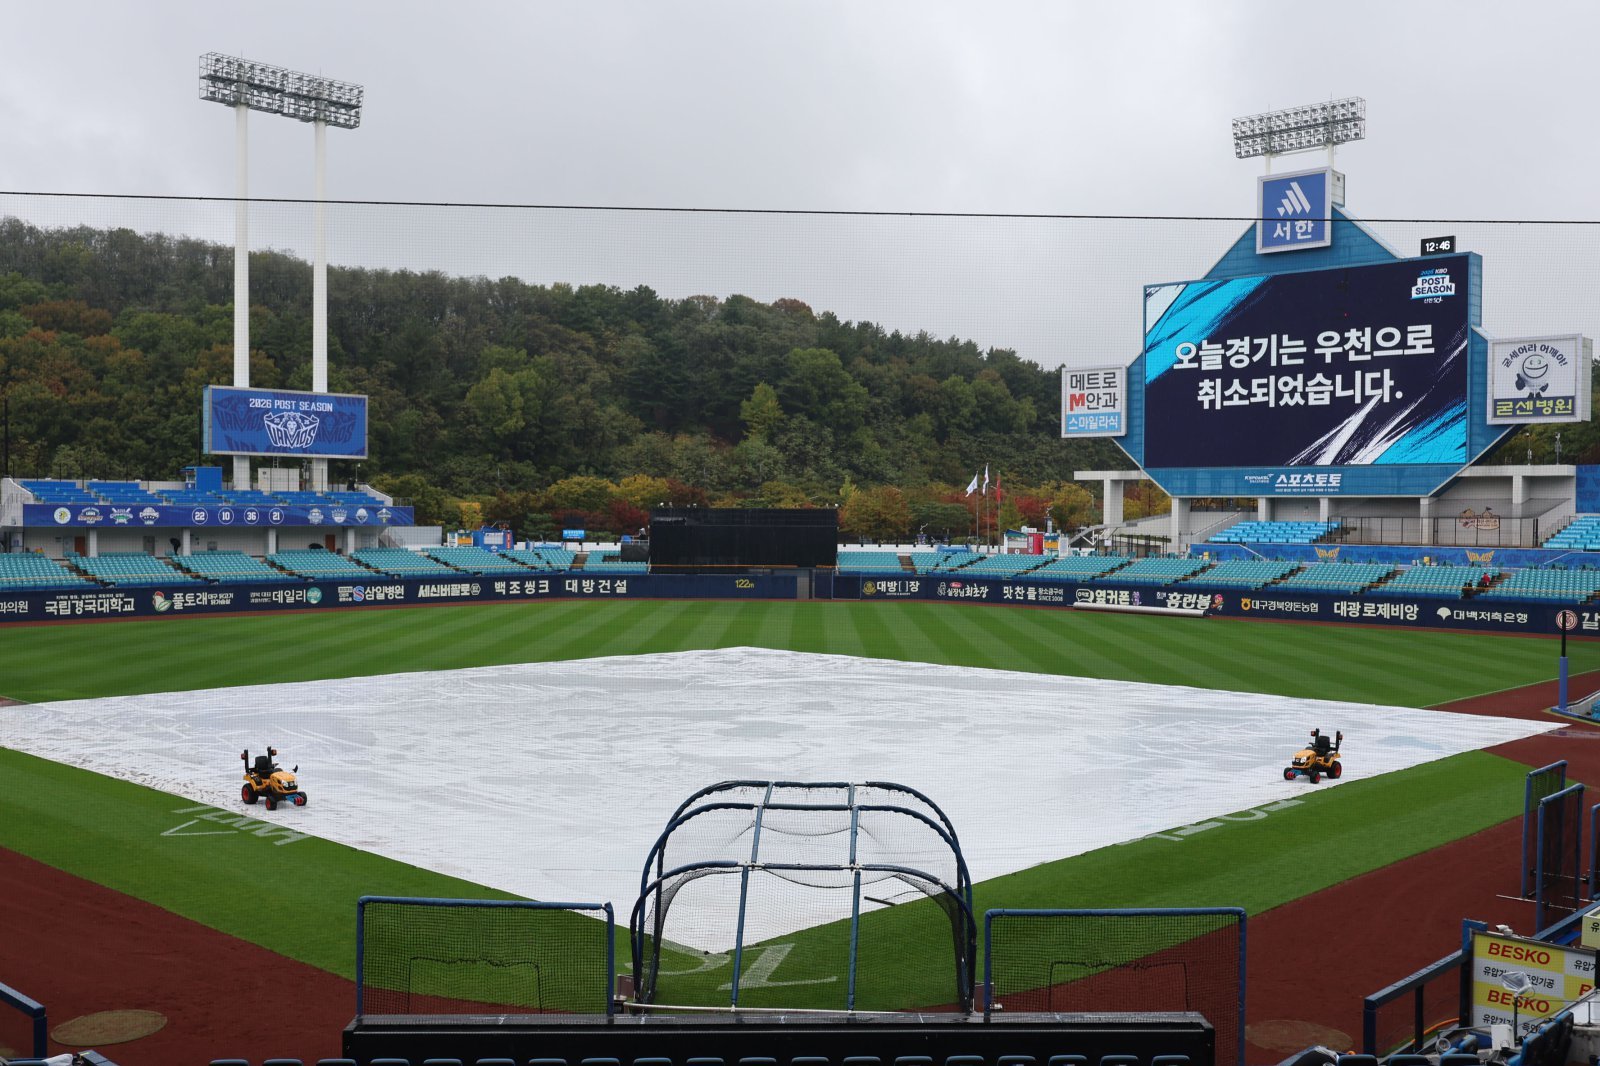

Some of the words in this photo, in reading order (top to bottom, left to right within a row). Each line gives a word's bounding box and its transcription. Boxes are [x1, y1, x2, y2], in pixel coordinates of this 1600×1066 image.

[1273, 220, 1314, 240] 서한
[1425, 241, 1451, 252] 12:46
[1421, 277, 1446, 286] POST
[1415, 284, 1453, 295] SEASON
[1173, 334, 1306, 370] 오늘경기는
[1314, 324, 1435, 363] 우천으로
[1540, 344, 1568, 367] 어깨야!
[1070, 372, 1117, 391] 메트로
[1197, 368, 1403, 410] 취소되었습니다.
[274, 400, 296, 410] POST
[299, 401, 333, 412] SEASON
[1496, 399, 1572, 416] 굳센병원
[1069, 416, 1118, 430] 스마일라식
[1275, 473, 1342, 487] 스포츠토토
[195, 512, 205, 520] 22
[222, 512, 231, 520] 10
[247, 512, 256, 520] 36
[272, 512, 280, 520] 21
[418, 583, 470, 598] 세신버팔로
[494, 580, 550, 595] 백조씽크
[565, 579, 627, 594] 대방건설
[735, 579, 754, 588] 122m
[272, 589, 306, 603] 데일리
[365, 585, 404, 600] 삼일병원
[1003, 586, 1037, 601] 맛찬들
[1095, 589, 1130, 605] 옆커폰
[45, 597, 135, 615] 국립경국대학교
[172, 592, 208, 610] 풀토래
[1251, 600, 1319, 613] 대구경북양돈농협
[1453, 610, 1528, 624] 대백저축은행
[1488, 942, 1551, 965] BESKO
[1487, 989, 1550, 1013] BESKO
